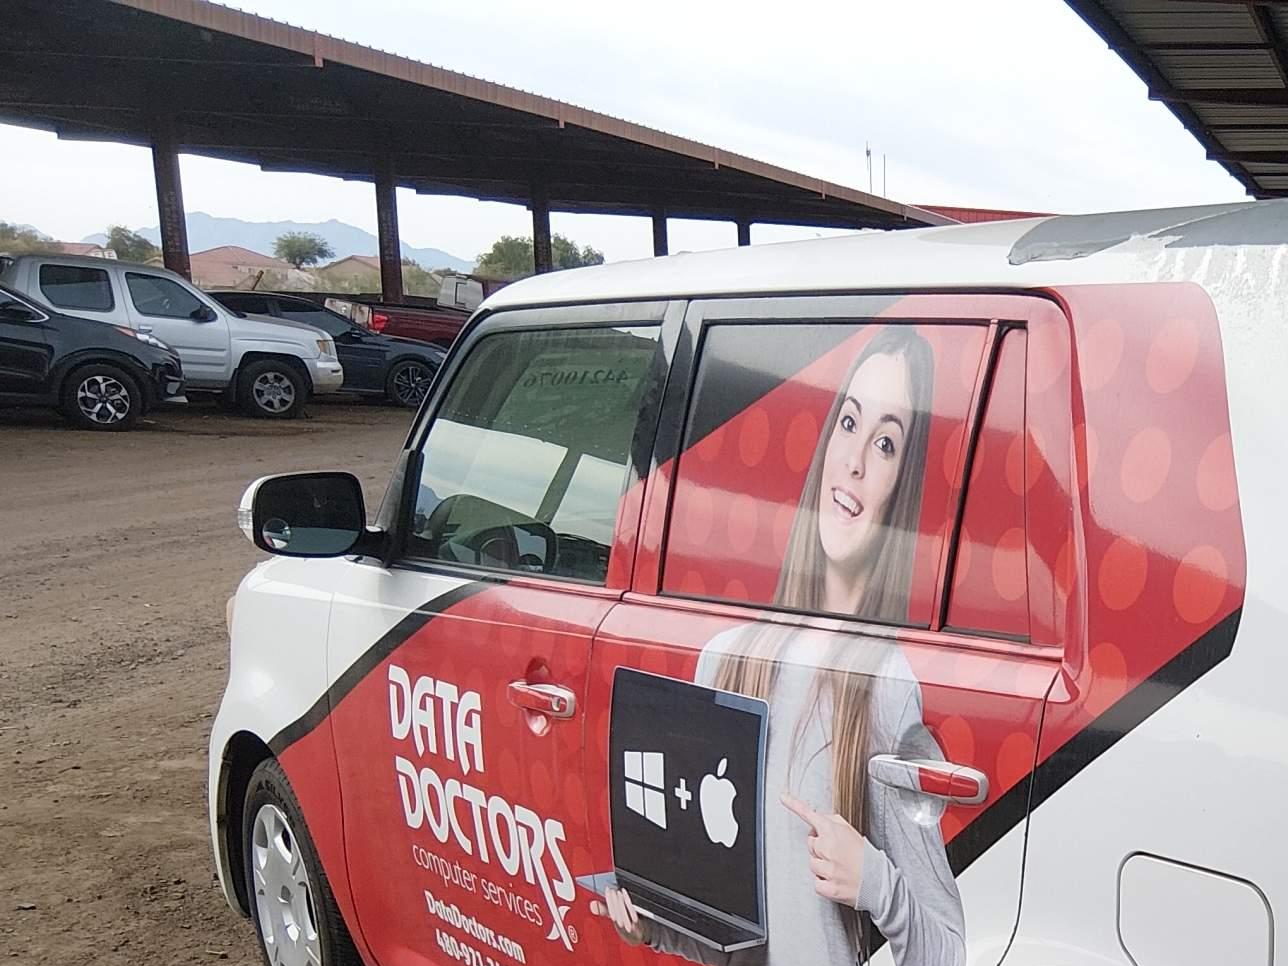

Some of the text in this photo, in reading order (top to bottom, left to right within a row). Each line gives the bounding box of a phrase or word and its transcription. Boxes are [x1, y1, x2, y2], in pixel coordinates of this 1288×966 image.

[387, 663, 485, 776] DATA
[395, 755, 576, 952] DOCTORS
[412, 844, 544, 926] computer services
[424, 889, 527, 965] DataDoctors.com
